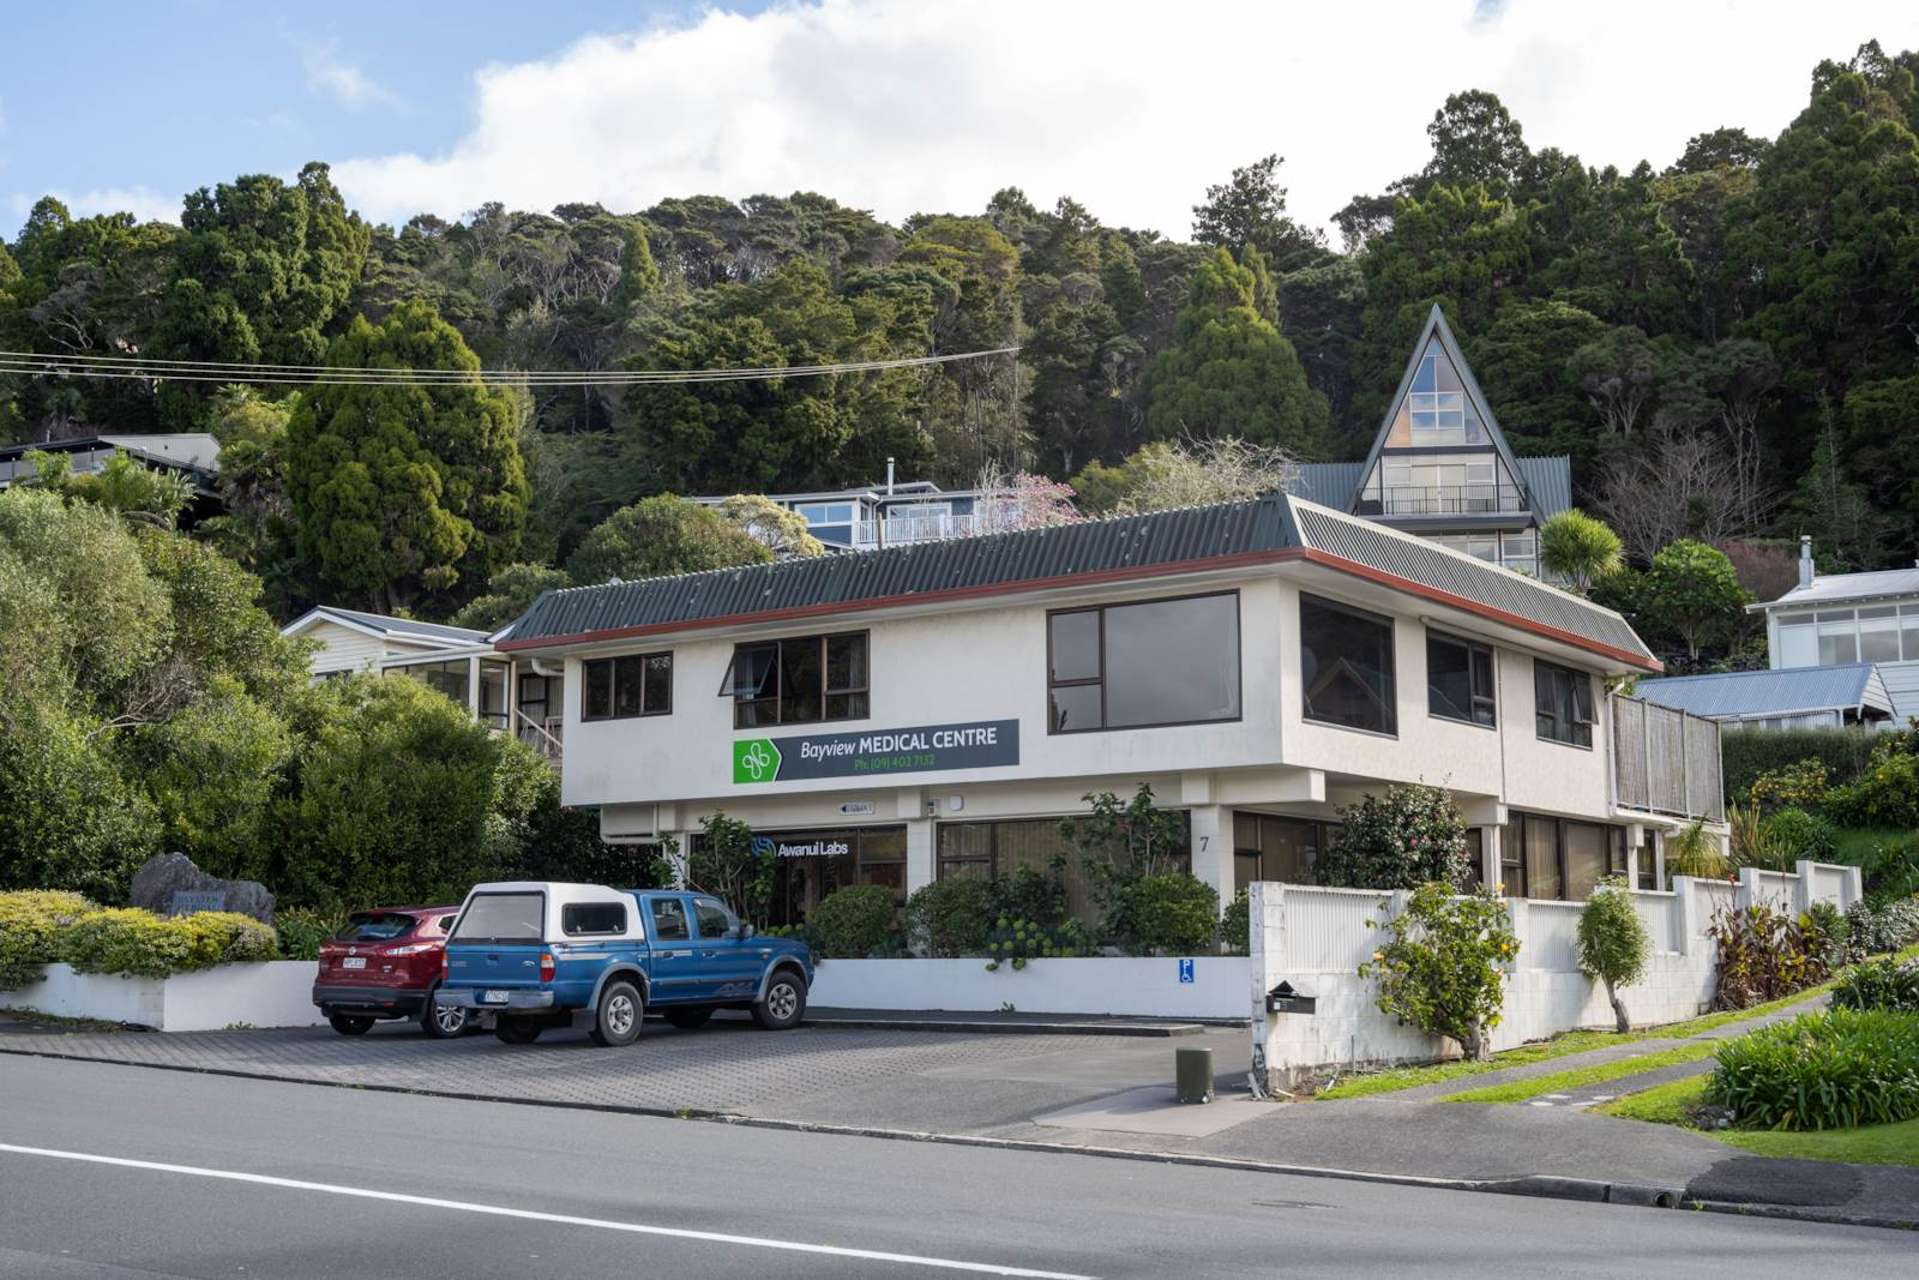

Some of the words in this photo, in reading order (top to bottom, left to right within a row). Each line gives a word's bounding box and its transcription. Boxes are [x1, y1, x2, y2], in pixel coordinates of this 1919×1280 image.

[801, 739, 856, 762] Bayview
[859, 734, 929, 754] MEDICAL
[932, 727, 997, 748] CENTRE
[778, 842, 819, 857] Awanui
[820, 841, 848, 855] Labs
[1200, 836, 1209, 852] 7
[1183, 960, 1190, 970] P
